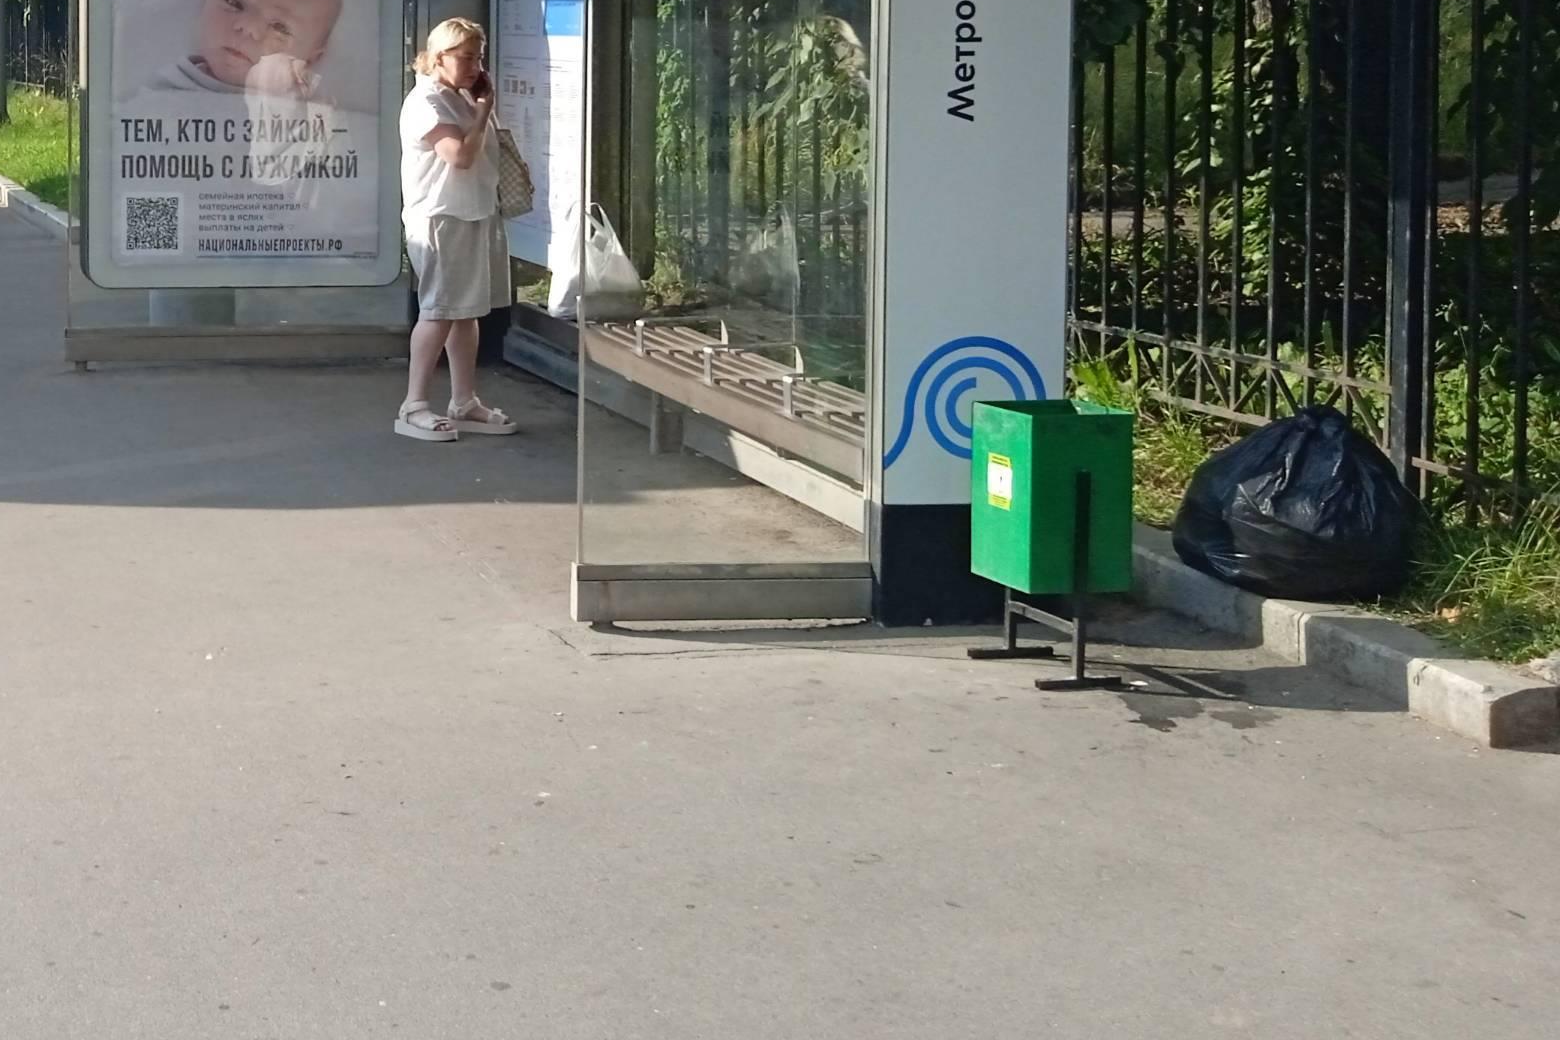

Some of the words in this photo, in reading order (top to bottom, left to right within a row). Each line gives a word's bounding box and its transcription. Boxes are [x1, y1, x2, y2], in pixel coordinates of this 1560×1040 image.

[121, 118, 169, 145] ТЕМ,
[177, 118, 216, 143] КТО
[223, 118, 235, 143] С
[243, 114, 326, 143] ЗАЙКОЙ
[121, 154, 214, 181] ПОМОЩЬ
[221, 154, 233, 179] С
[239, 150, 358, 179] ЛУЖАЙКОЙ
[198, 191, 245, 202] семейная
[246, 192, 284, 202] ипотека
[198, 202, 260, 212] материнский
[262, 202, 301, 211] капитал
[198, 213, 227, 222] места
[198, 223, 242, 233] выплаты
[243, 224, 255, 232] на
[256, 223, 284, 234] детей
[198, 238, 343, 253] НАЦИОНАЛЬНЫЕПРОЕКТЫ.РФ
